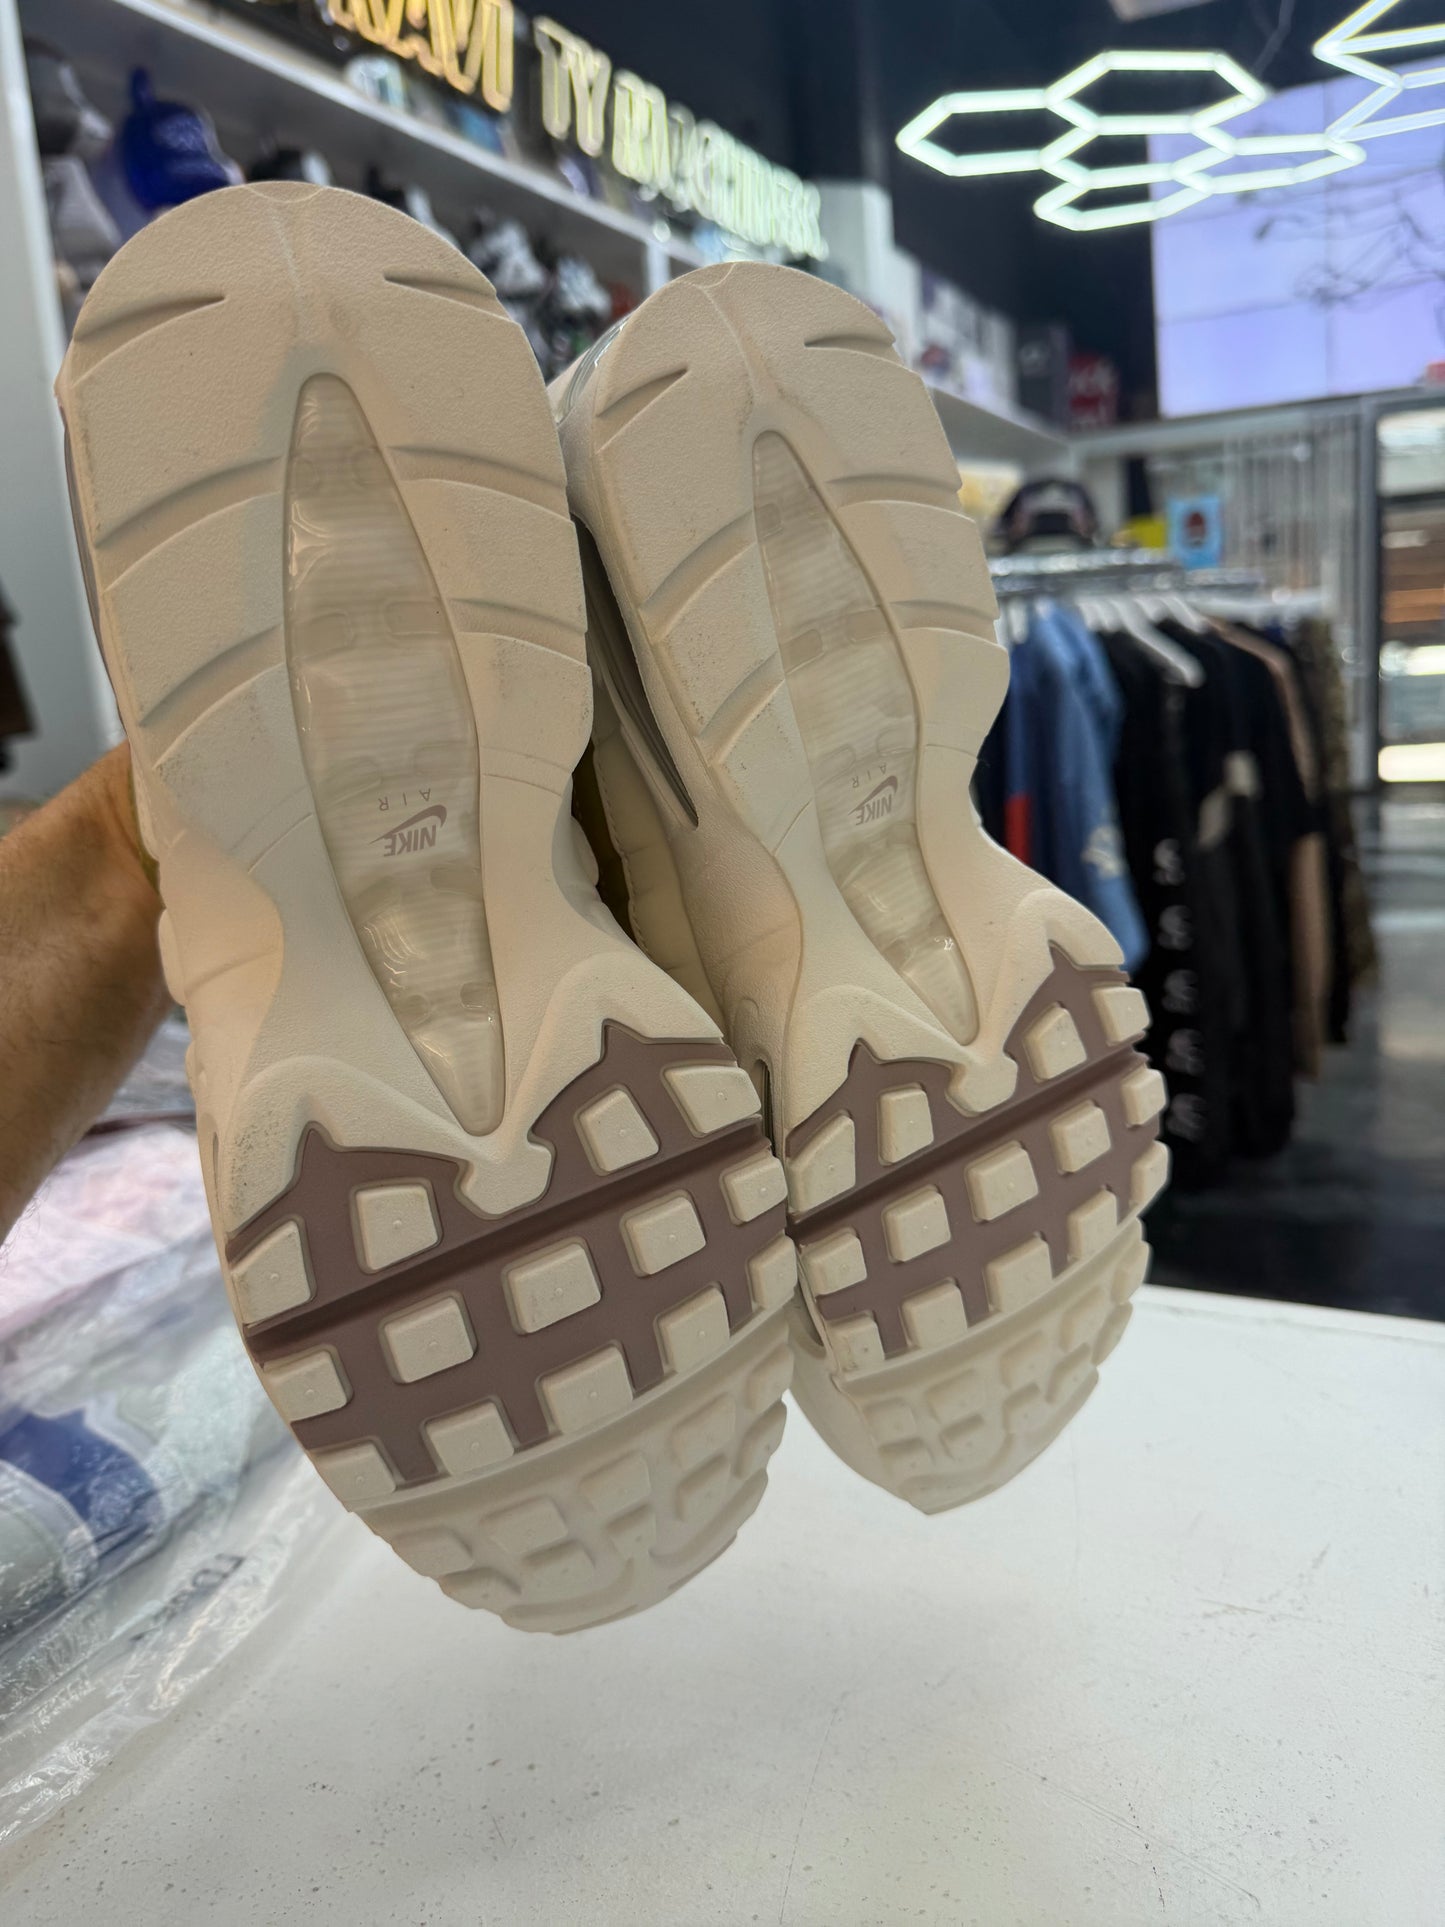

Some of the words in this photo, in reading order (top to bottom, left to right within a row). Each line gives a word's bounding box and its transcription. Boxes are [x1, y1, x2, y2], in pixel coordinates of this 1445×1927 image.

[851, 762, 887, 789] AIR
[378, 788, 431, 812] AIR
[855, 794, 893, 826] NIKE
[383, 824, 437, 857] NIKE
